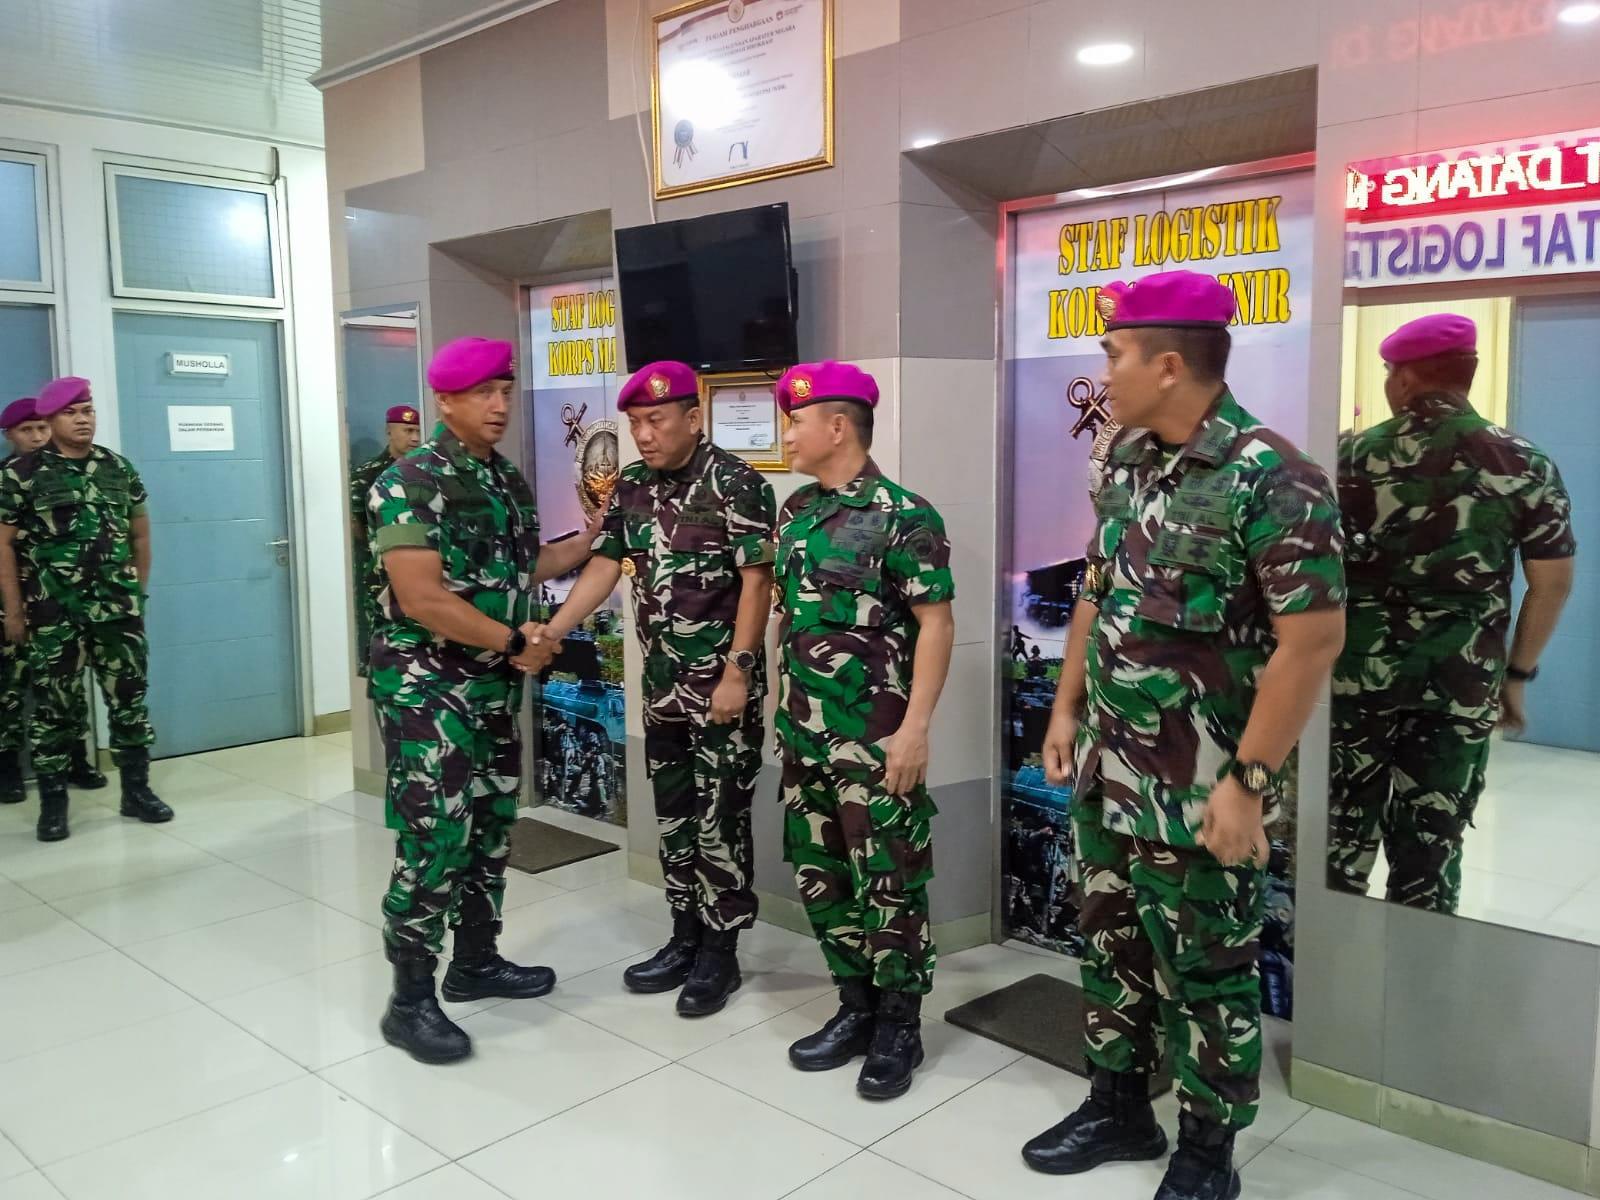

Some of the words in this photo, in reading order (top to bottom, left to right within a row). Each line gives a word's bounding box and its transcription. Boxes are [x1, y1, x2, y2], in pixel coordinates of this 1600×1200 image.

[1058, 216, 1128, 275] STAF
[1132, 196, 1282, 267] LOGISTIK
[551, 293, 585, 332] STAF
[1048, 286, 1106, 339] KOR
[176, 359, 225, 369] MUSHOLLA
[548, 338, 595, 376] KORPS
